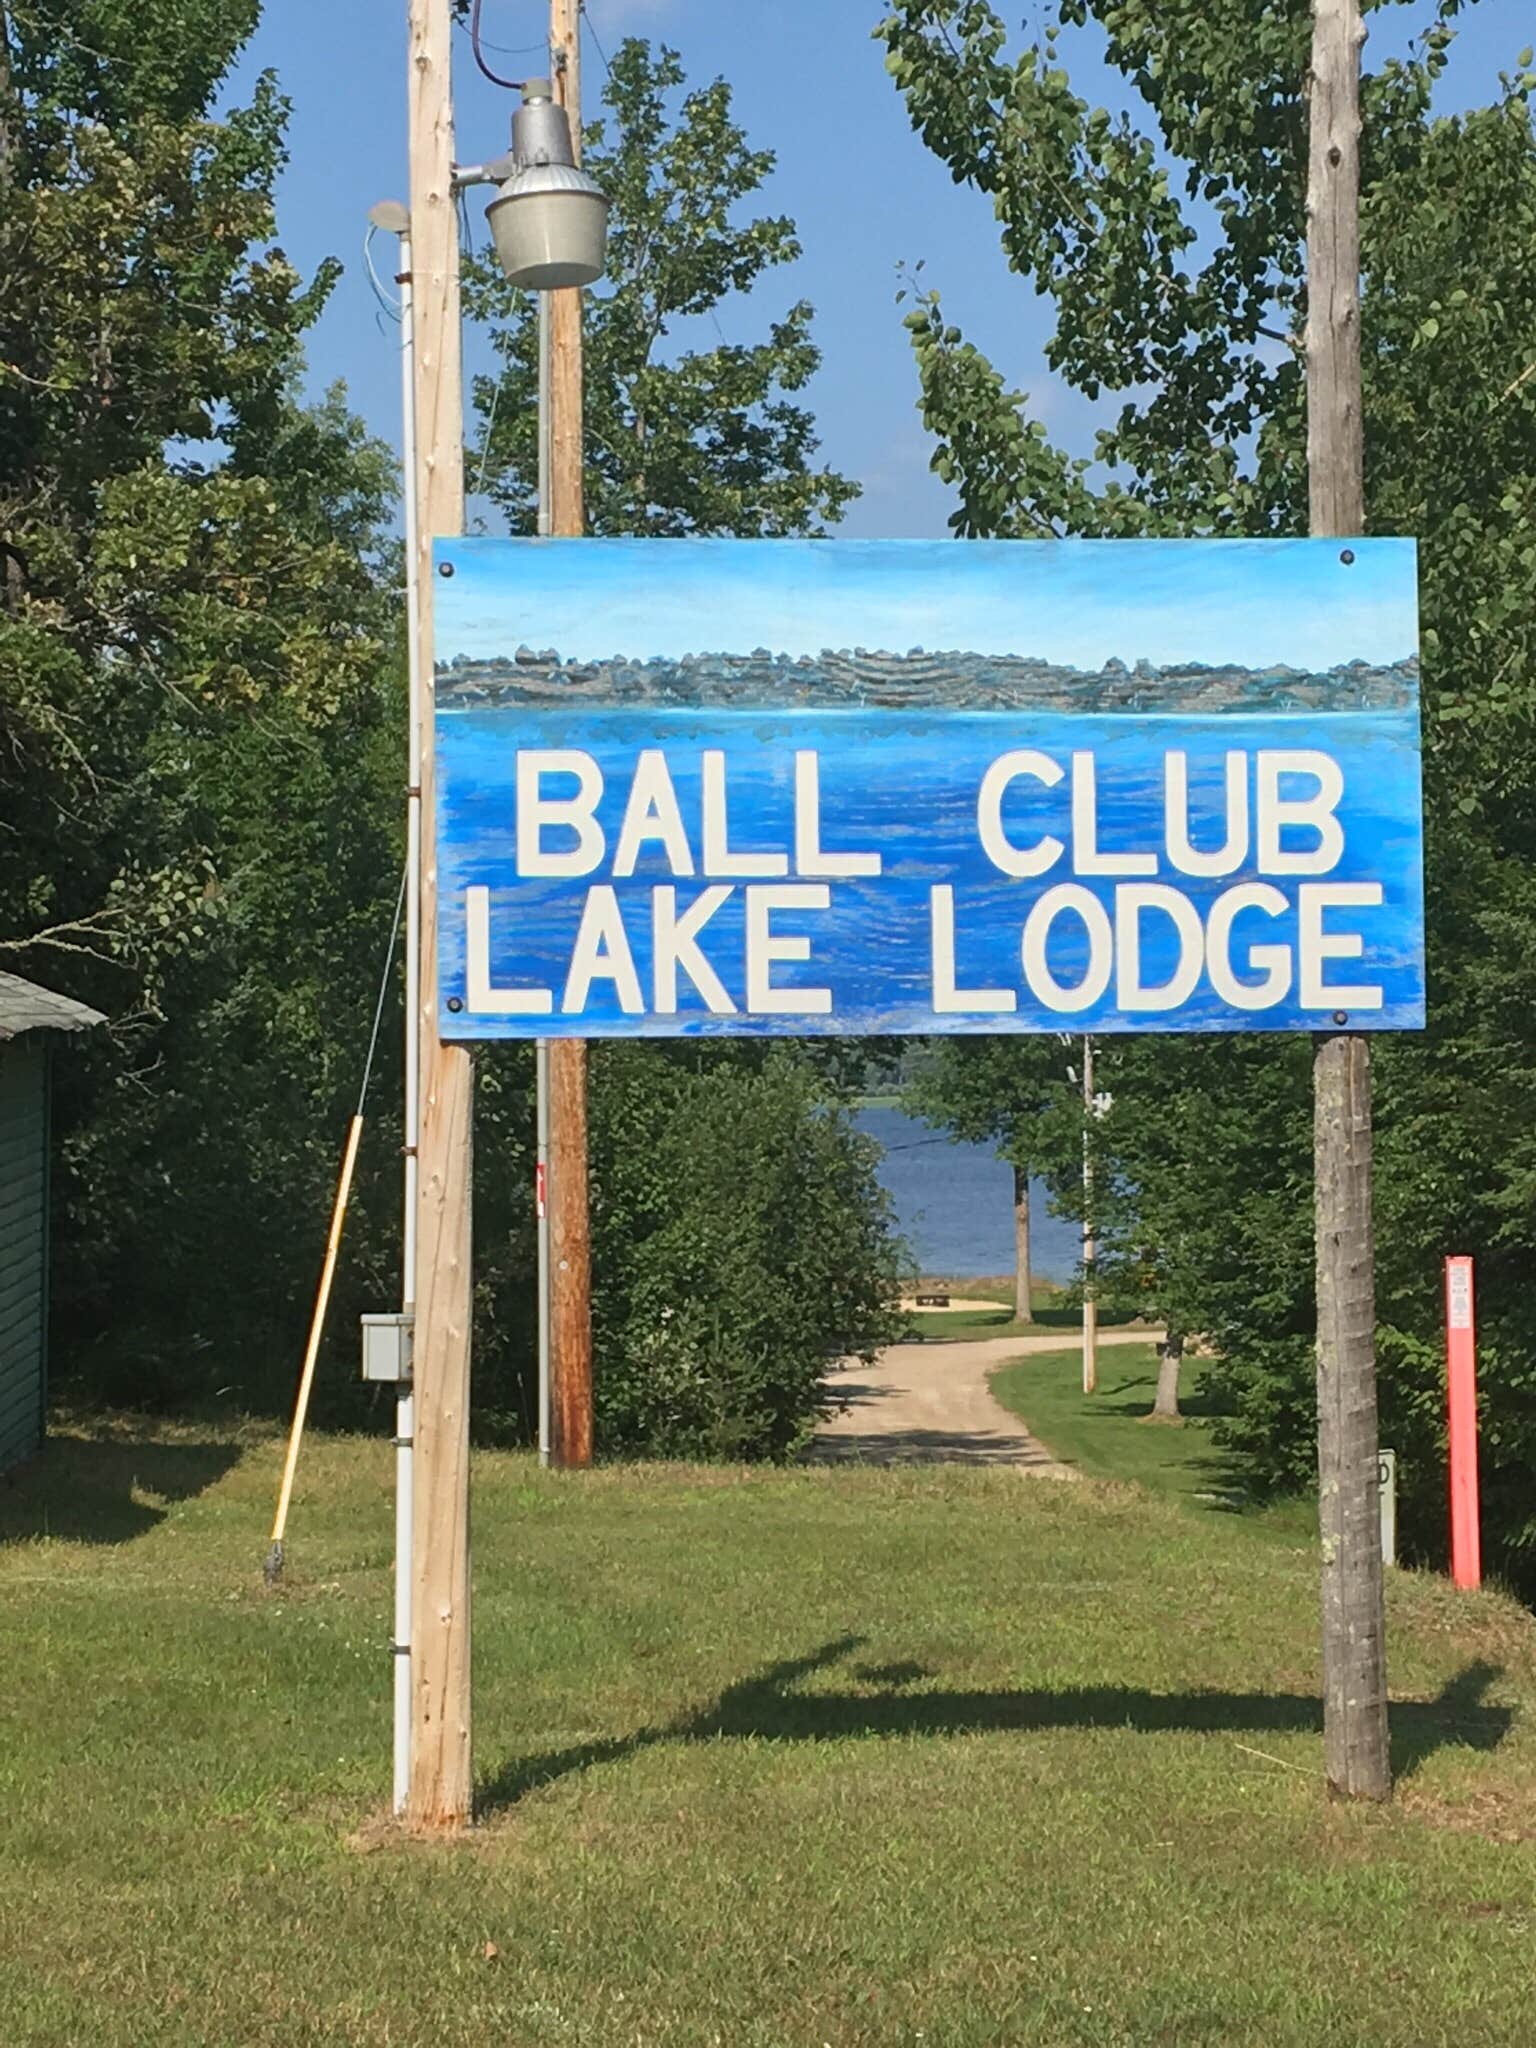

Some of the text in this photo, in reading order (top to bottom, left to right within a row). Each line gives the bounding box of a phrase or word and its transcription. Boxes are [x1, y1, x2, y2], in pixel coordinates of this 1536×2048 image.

[516, 749, 1344, 878] BALL CLUB
[465, 881, 1383, 1015] LAKE LODGE
